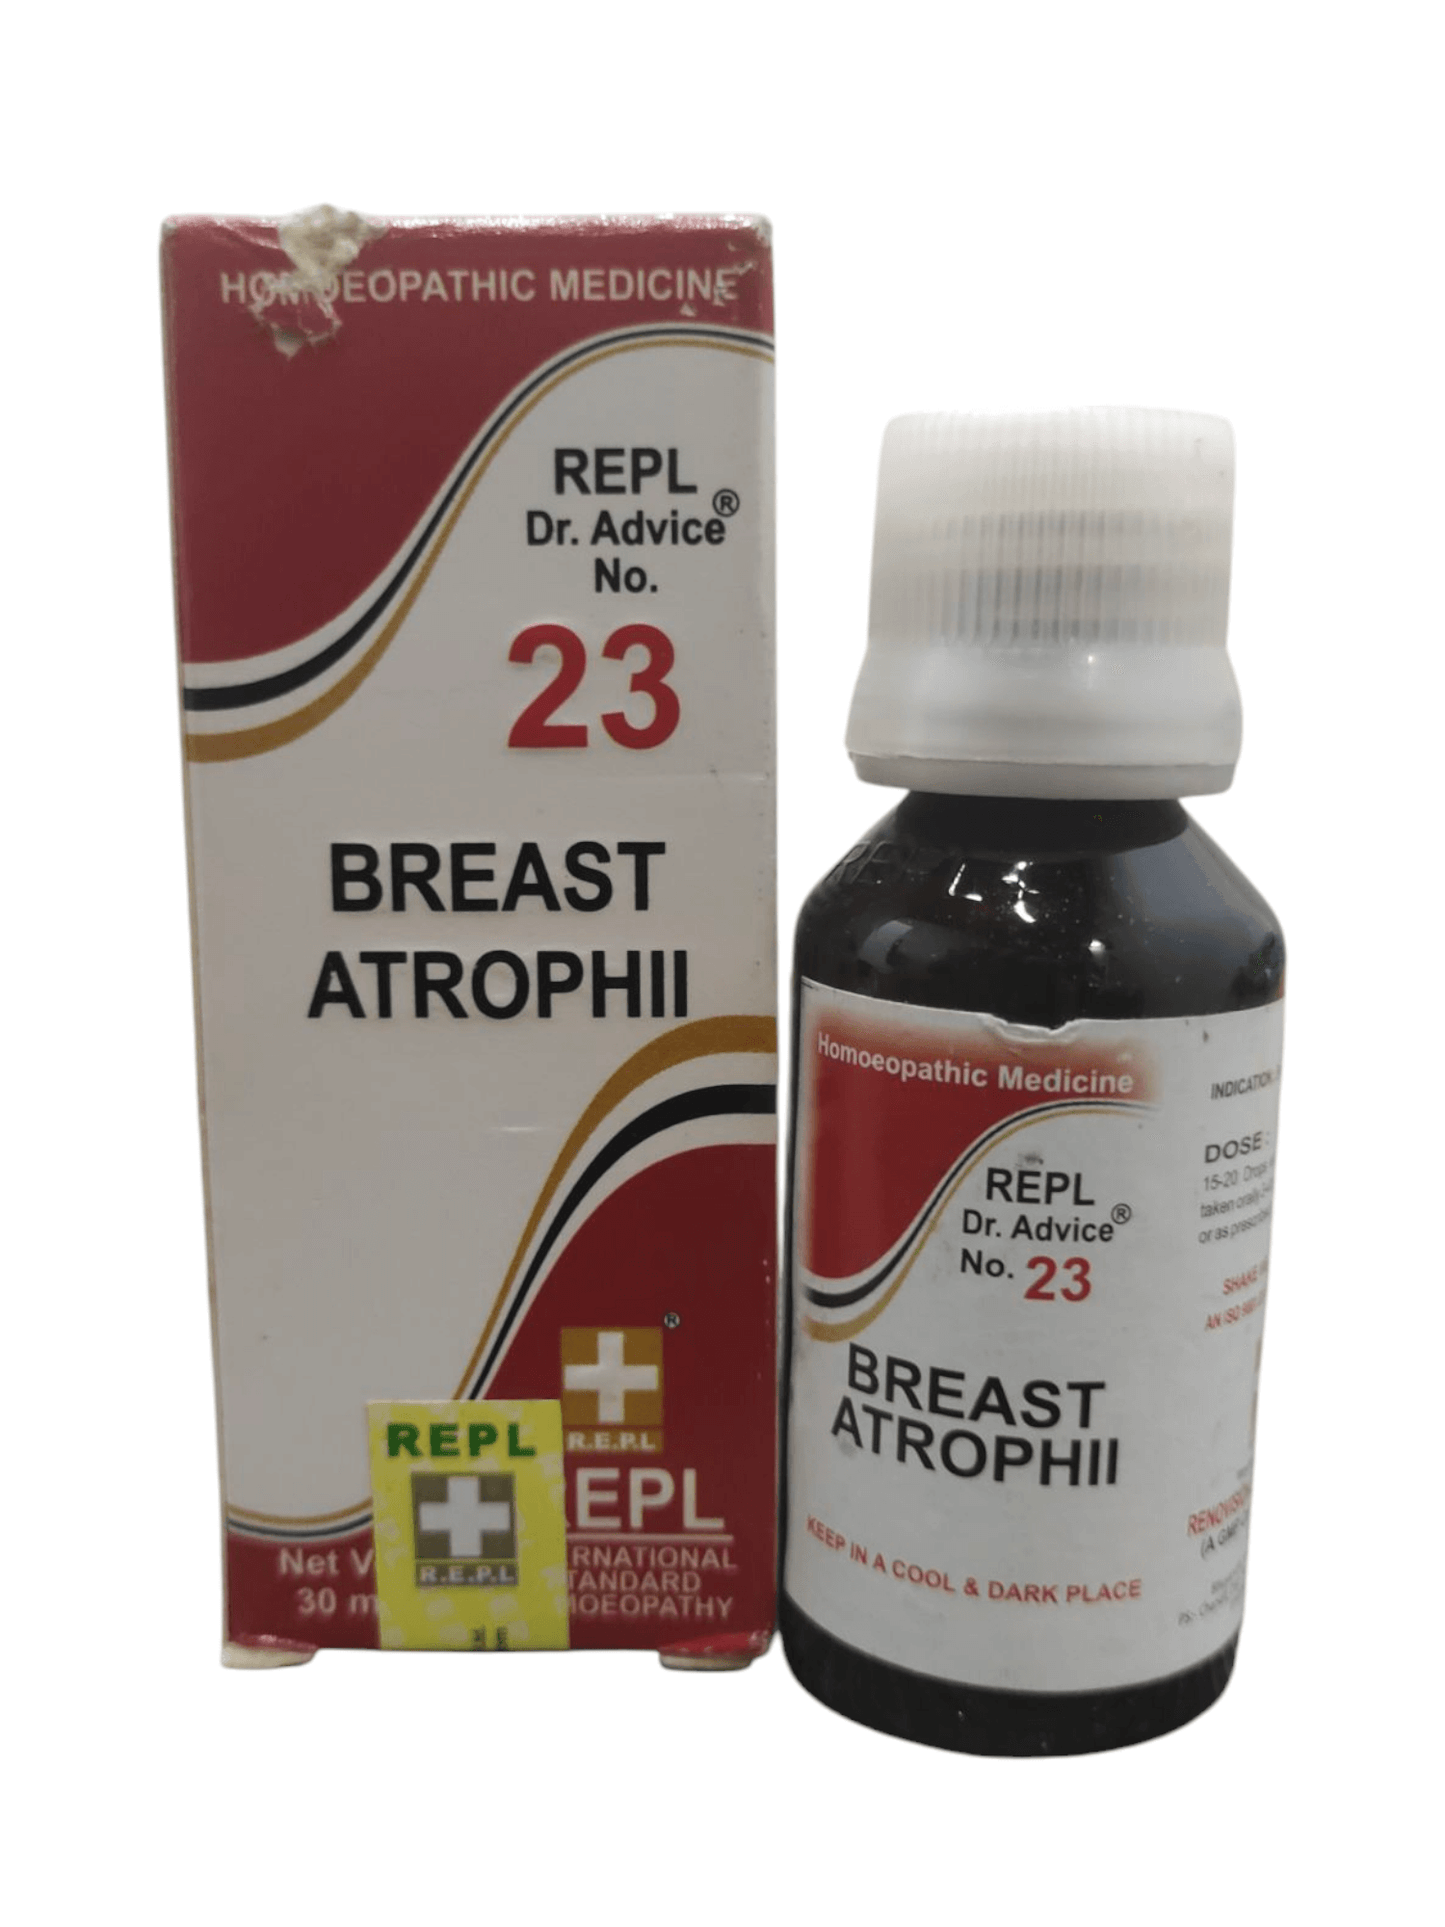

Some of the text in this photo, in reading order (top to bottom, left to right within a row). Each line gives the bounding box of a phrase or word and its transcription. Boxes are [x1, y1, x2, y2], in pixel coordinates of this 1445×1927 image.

[550, 267, 738, 303] MEDICINE
[553, 447, 699, 495] REPL
[526, 510, 579, 546] Dr.
[593, 557, 659, 594] No.
[507, 623, 682, 750] 23
[330, 840, 666, 913] BREAST
[307, 949, 688, 1020] ATROPHII
[816, 1030, 1134, 1094] Homoeopathic Medicine
[1204, 1130, 1263, 1164] DOSE
[985, 1166, 1096, 1207] REPL
[962, 1207, 1002, 1239] Dr.
[959, 1248, 1093, 1302] No. 23
[847, 1342, 1106, 1429] BREAST
[386, 1422, 538, 1458] REPL
[830, 1396, 1120, 1487] ATROPHII
[567, 1466, 726, 1530] EPL
[279, 1547, 375, 1578] Net V
[419, 1564, 516, 1585] R.E.P.L
[571, 1545, 738, 1570] RNATIONAL
[805, 1513, 1143, 1604] KEEP IN A COOL & DARK PLACE
[567, 1569, 703, 1594] TANDARD
[297, 1586, 379, 1617] 30 m
[568, 1593, 734, 1619] OEOPATHY
